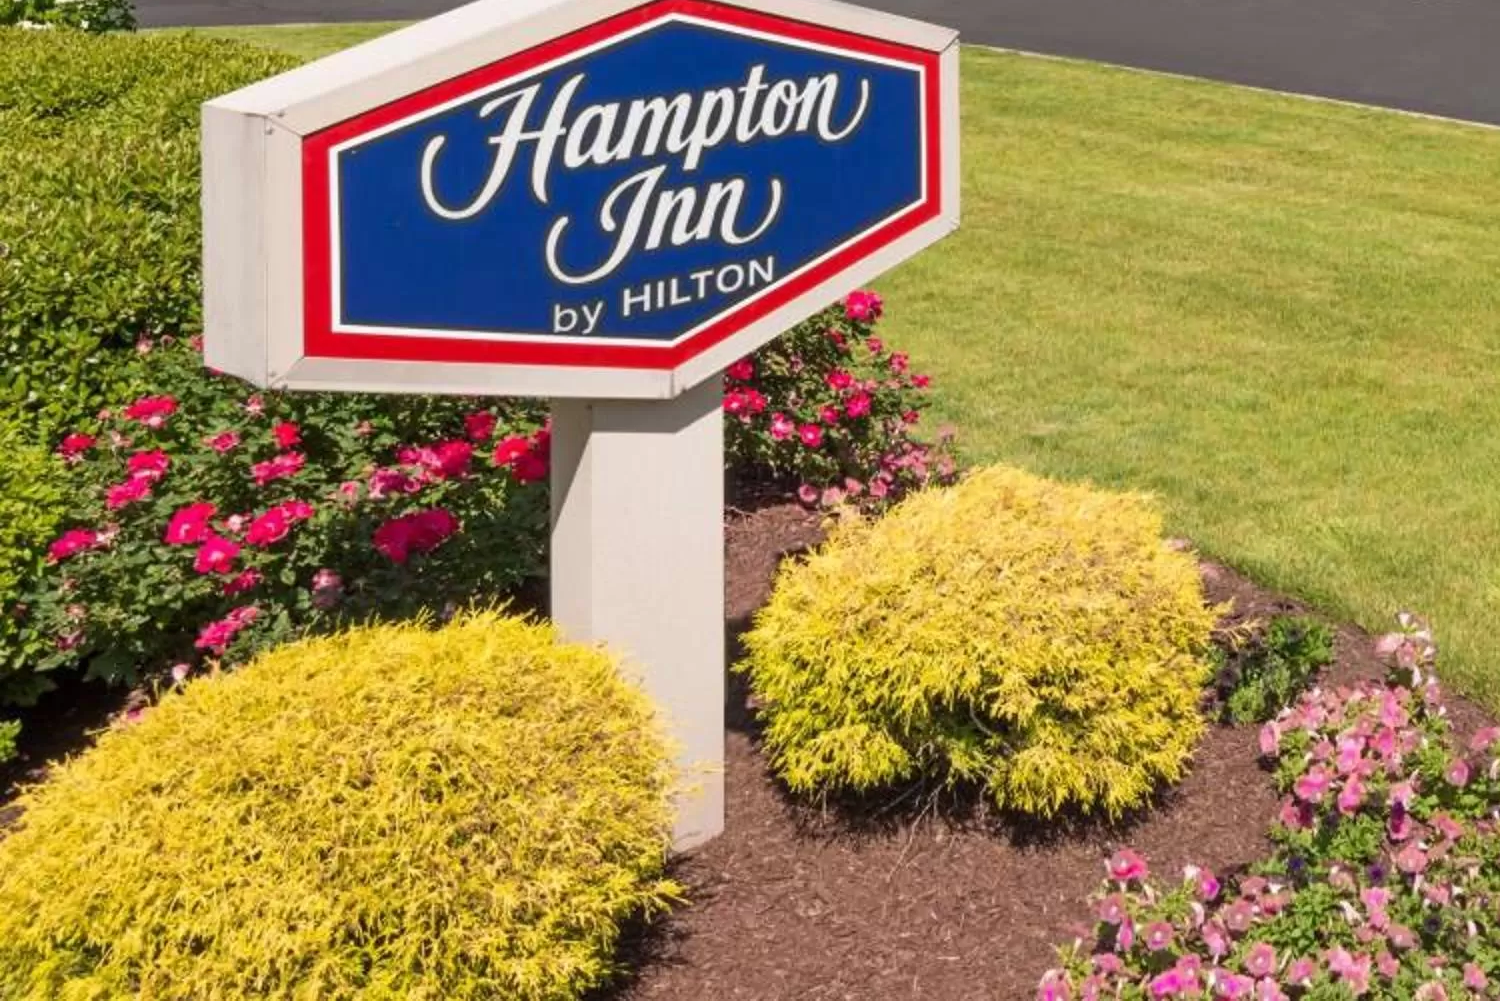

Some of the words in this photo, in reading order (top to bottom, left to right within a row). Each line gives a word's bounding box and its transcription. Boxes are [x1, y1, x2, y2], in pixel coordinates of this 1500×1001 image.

[421, 64, 869, 220] Hampton
[546, 165, 782, 284] Inn
[553, 301, 604, 334] by
[623, 256, 776, 317] HILTON
